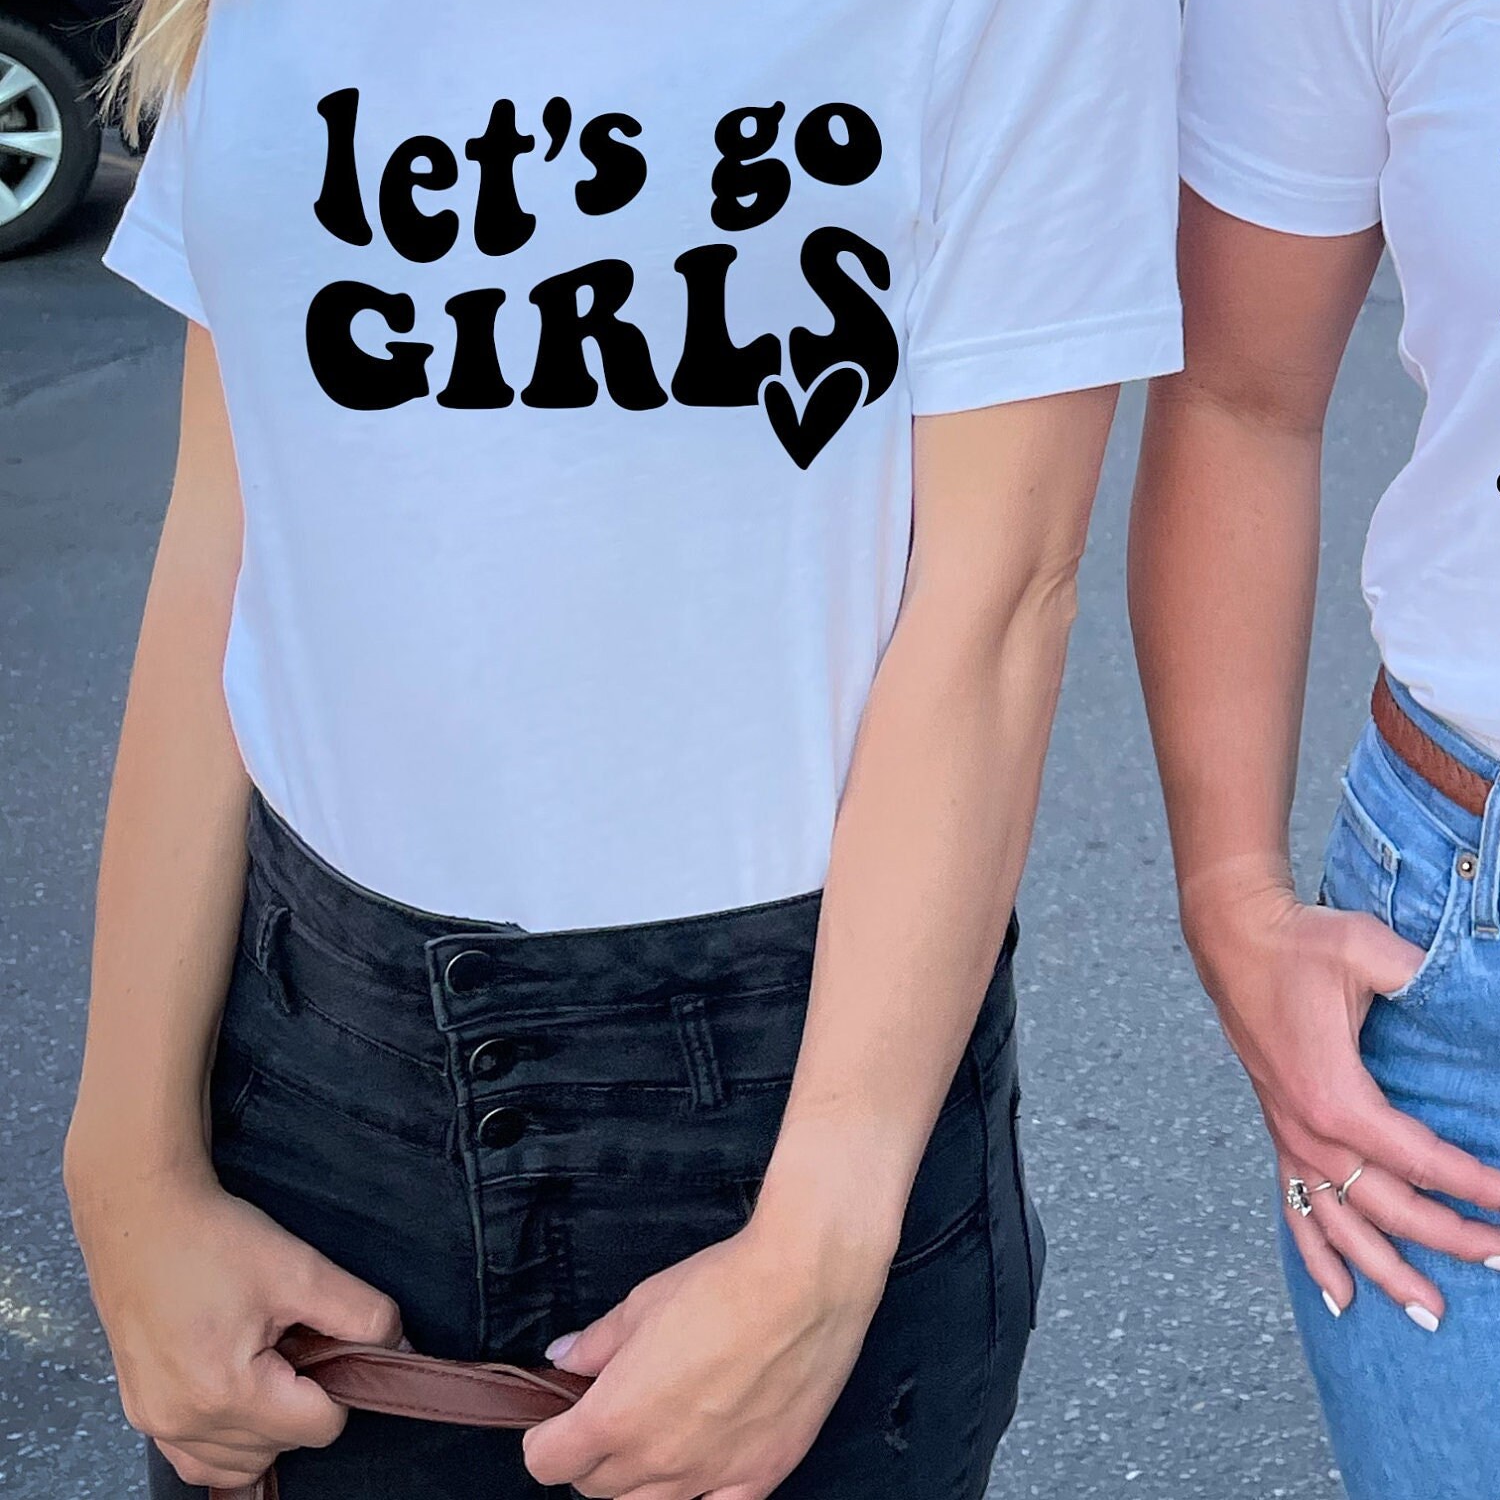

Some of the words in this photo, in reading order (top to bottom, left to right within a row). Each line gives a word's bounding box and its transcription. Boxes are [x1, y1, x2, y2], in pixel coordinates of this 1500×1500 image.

[314, 88, 647, 263] let's
[711, 101, 883, 231] go
[306, 227, 899, 410] GIRLS
